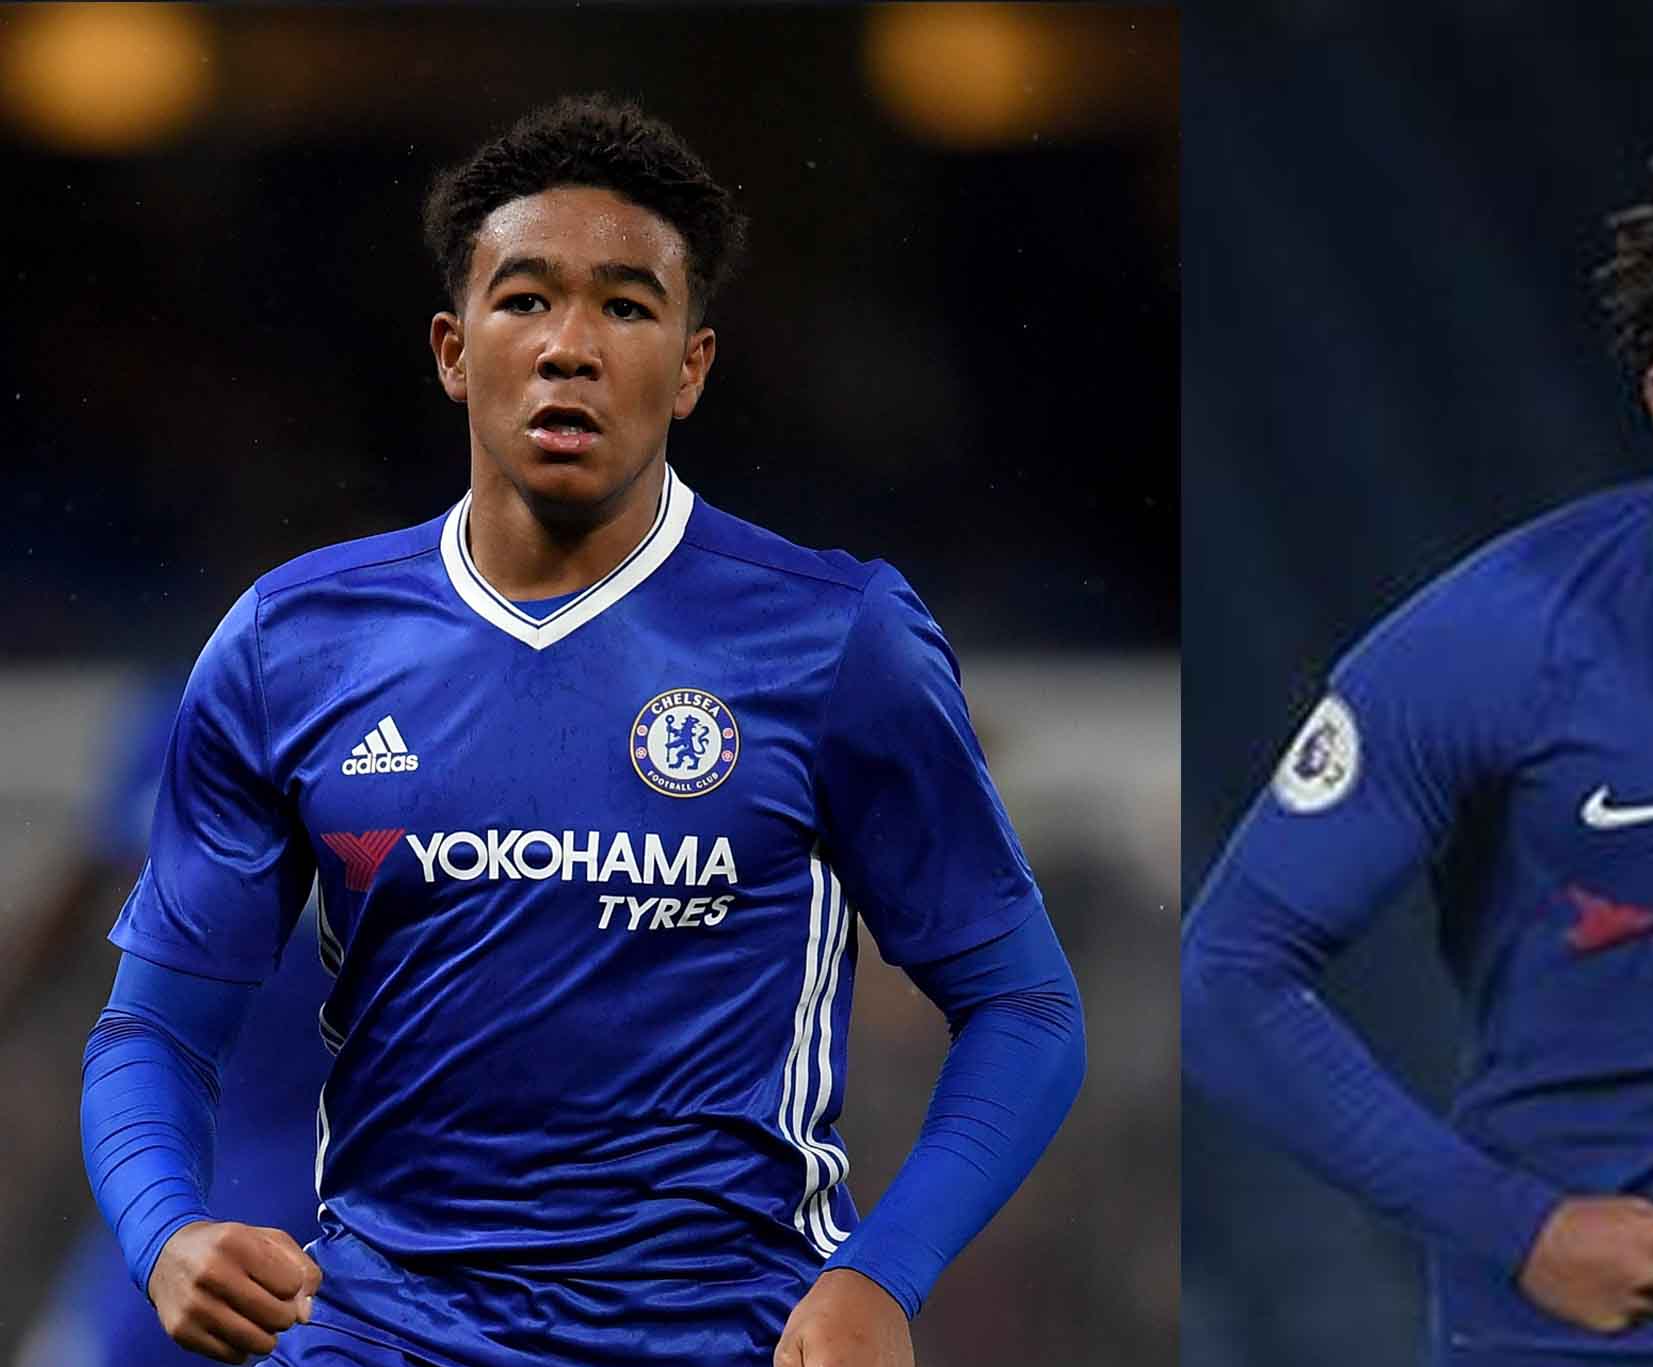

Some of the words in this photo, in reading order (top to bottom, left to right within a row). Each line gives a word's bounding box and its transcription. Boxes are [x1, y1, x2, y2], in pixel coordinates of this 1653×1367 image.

[651, 693, 720, 717] CHELSEA
[341, 752, 419, 776] adidas
[647, 770, 692, 791] FOOTBALL
[696, 772, 719, 789] CLUB
[405, 829, 738, 886] YOKOHAMA
[598, 895, 735, 931] TYRES
